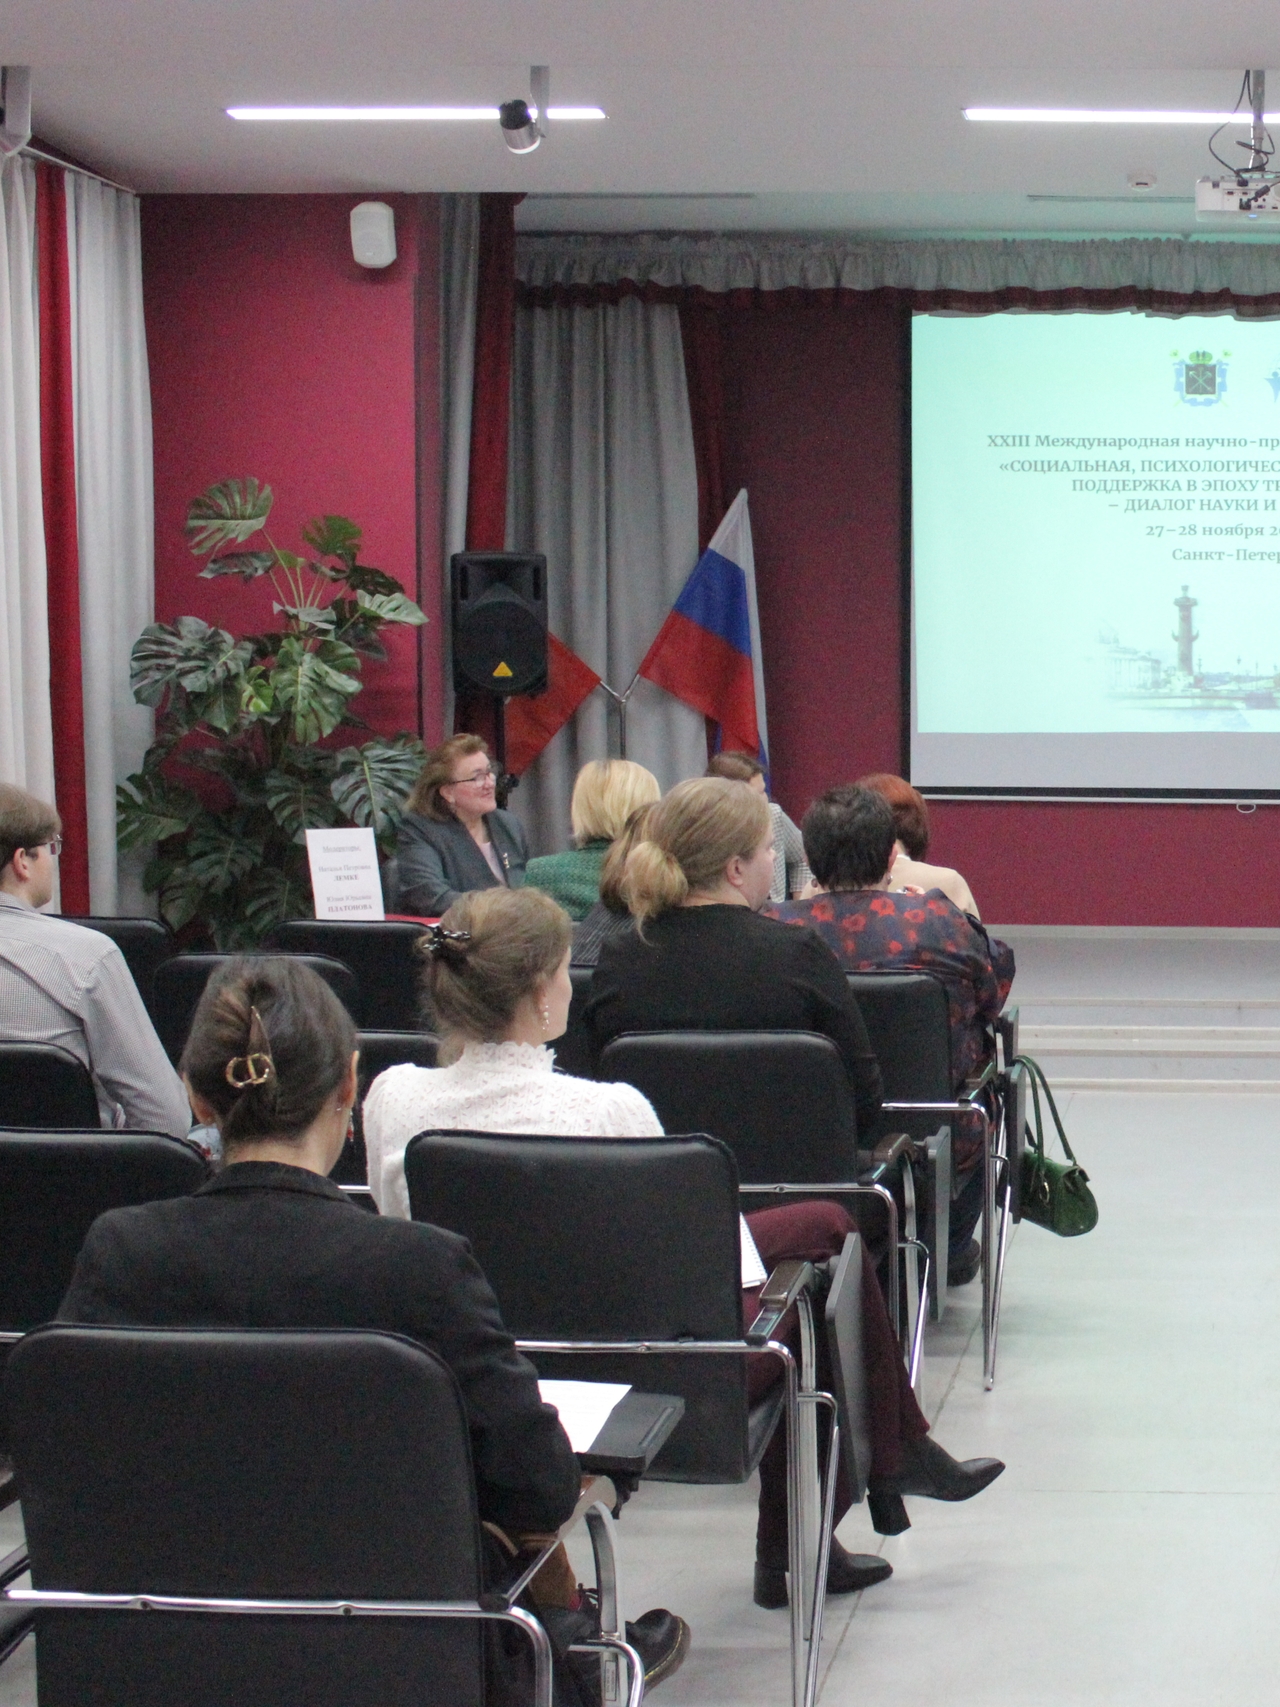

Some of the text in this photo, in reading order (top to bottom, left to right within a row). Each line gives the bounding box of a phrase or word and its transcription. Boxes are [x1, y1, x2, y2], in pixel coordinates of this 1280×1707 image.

[986, 434, 1031, 448] XXIII
[1034, 434, 1181, 451] Международная
[998, 459, 1136, 475] «СОЦИАЛЬНАЯ,
[1071, 478, 1183, 495] ПОДДЕРЖКА
[1186, 479, 1198, 492] В
[1201, 479, 1260, 492] ЭПОХУ
[1123, 498, 1196, 514] ДИАЛОГ
[1199, 498, 1259, 512] НАУКИ
[1263, 498, 1277, 512] И
[1145, 523, 1198, 539] 27–28
[1201, 522, 1265, 540] ноября
[328, 904, 372, 912] ПЛАТОНОВА
